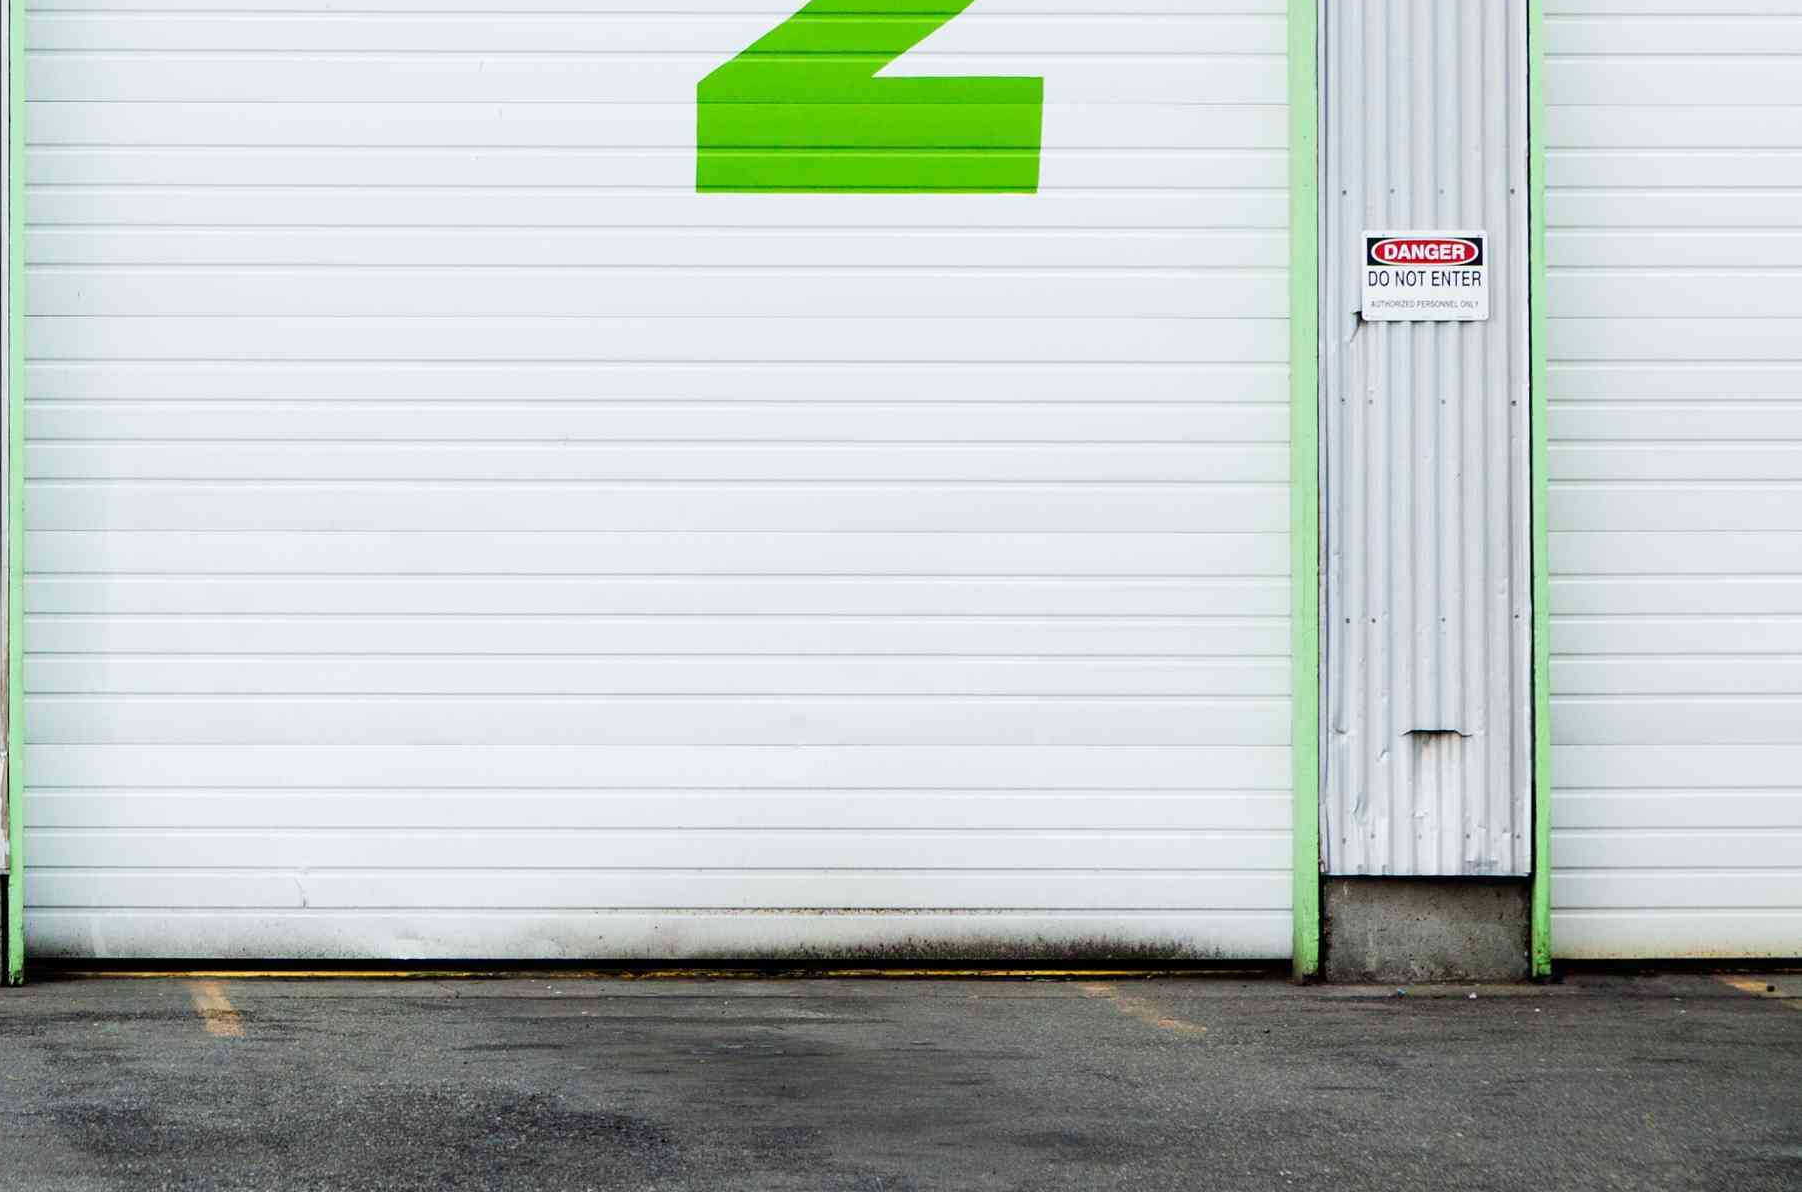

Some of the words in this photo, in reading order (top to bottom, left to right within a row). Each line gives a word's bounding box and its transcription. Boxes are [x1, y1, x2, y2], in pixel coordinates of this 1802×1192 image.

[1383, 244, 1466, 260] DANGER
[1368, 270, 1390, 287] DO
[1395, 270, 1426, 287] NOT
[1431, 270, 1482, 287] ENTER
